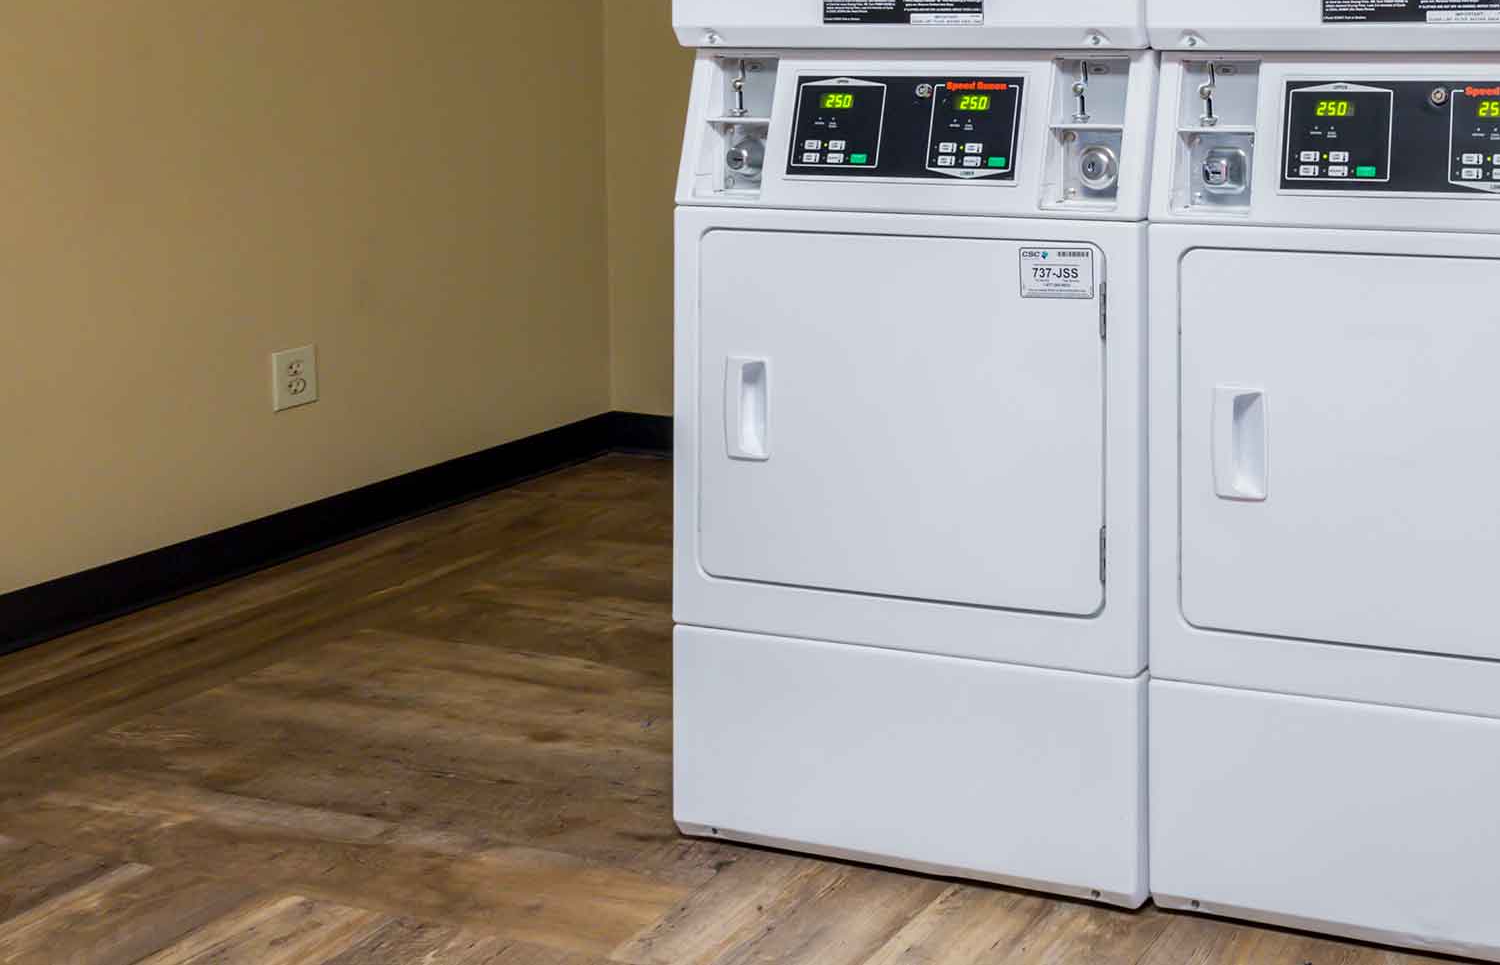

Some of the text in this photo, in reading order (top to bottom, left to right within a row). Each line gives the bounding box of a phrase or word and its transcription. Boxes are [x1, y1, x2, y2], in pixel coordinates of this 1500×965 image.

[946, 81, 1008, 92] Speed Queen
[1465, 86, 1500, 97] Speed
[825, 94, 853, 108] 250
[960, 96, 988, 110] 250
[1316, 101, 1347, 116] 250
[1032, 267, 1079, 278] 737-JSS
